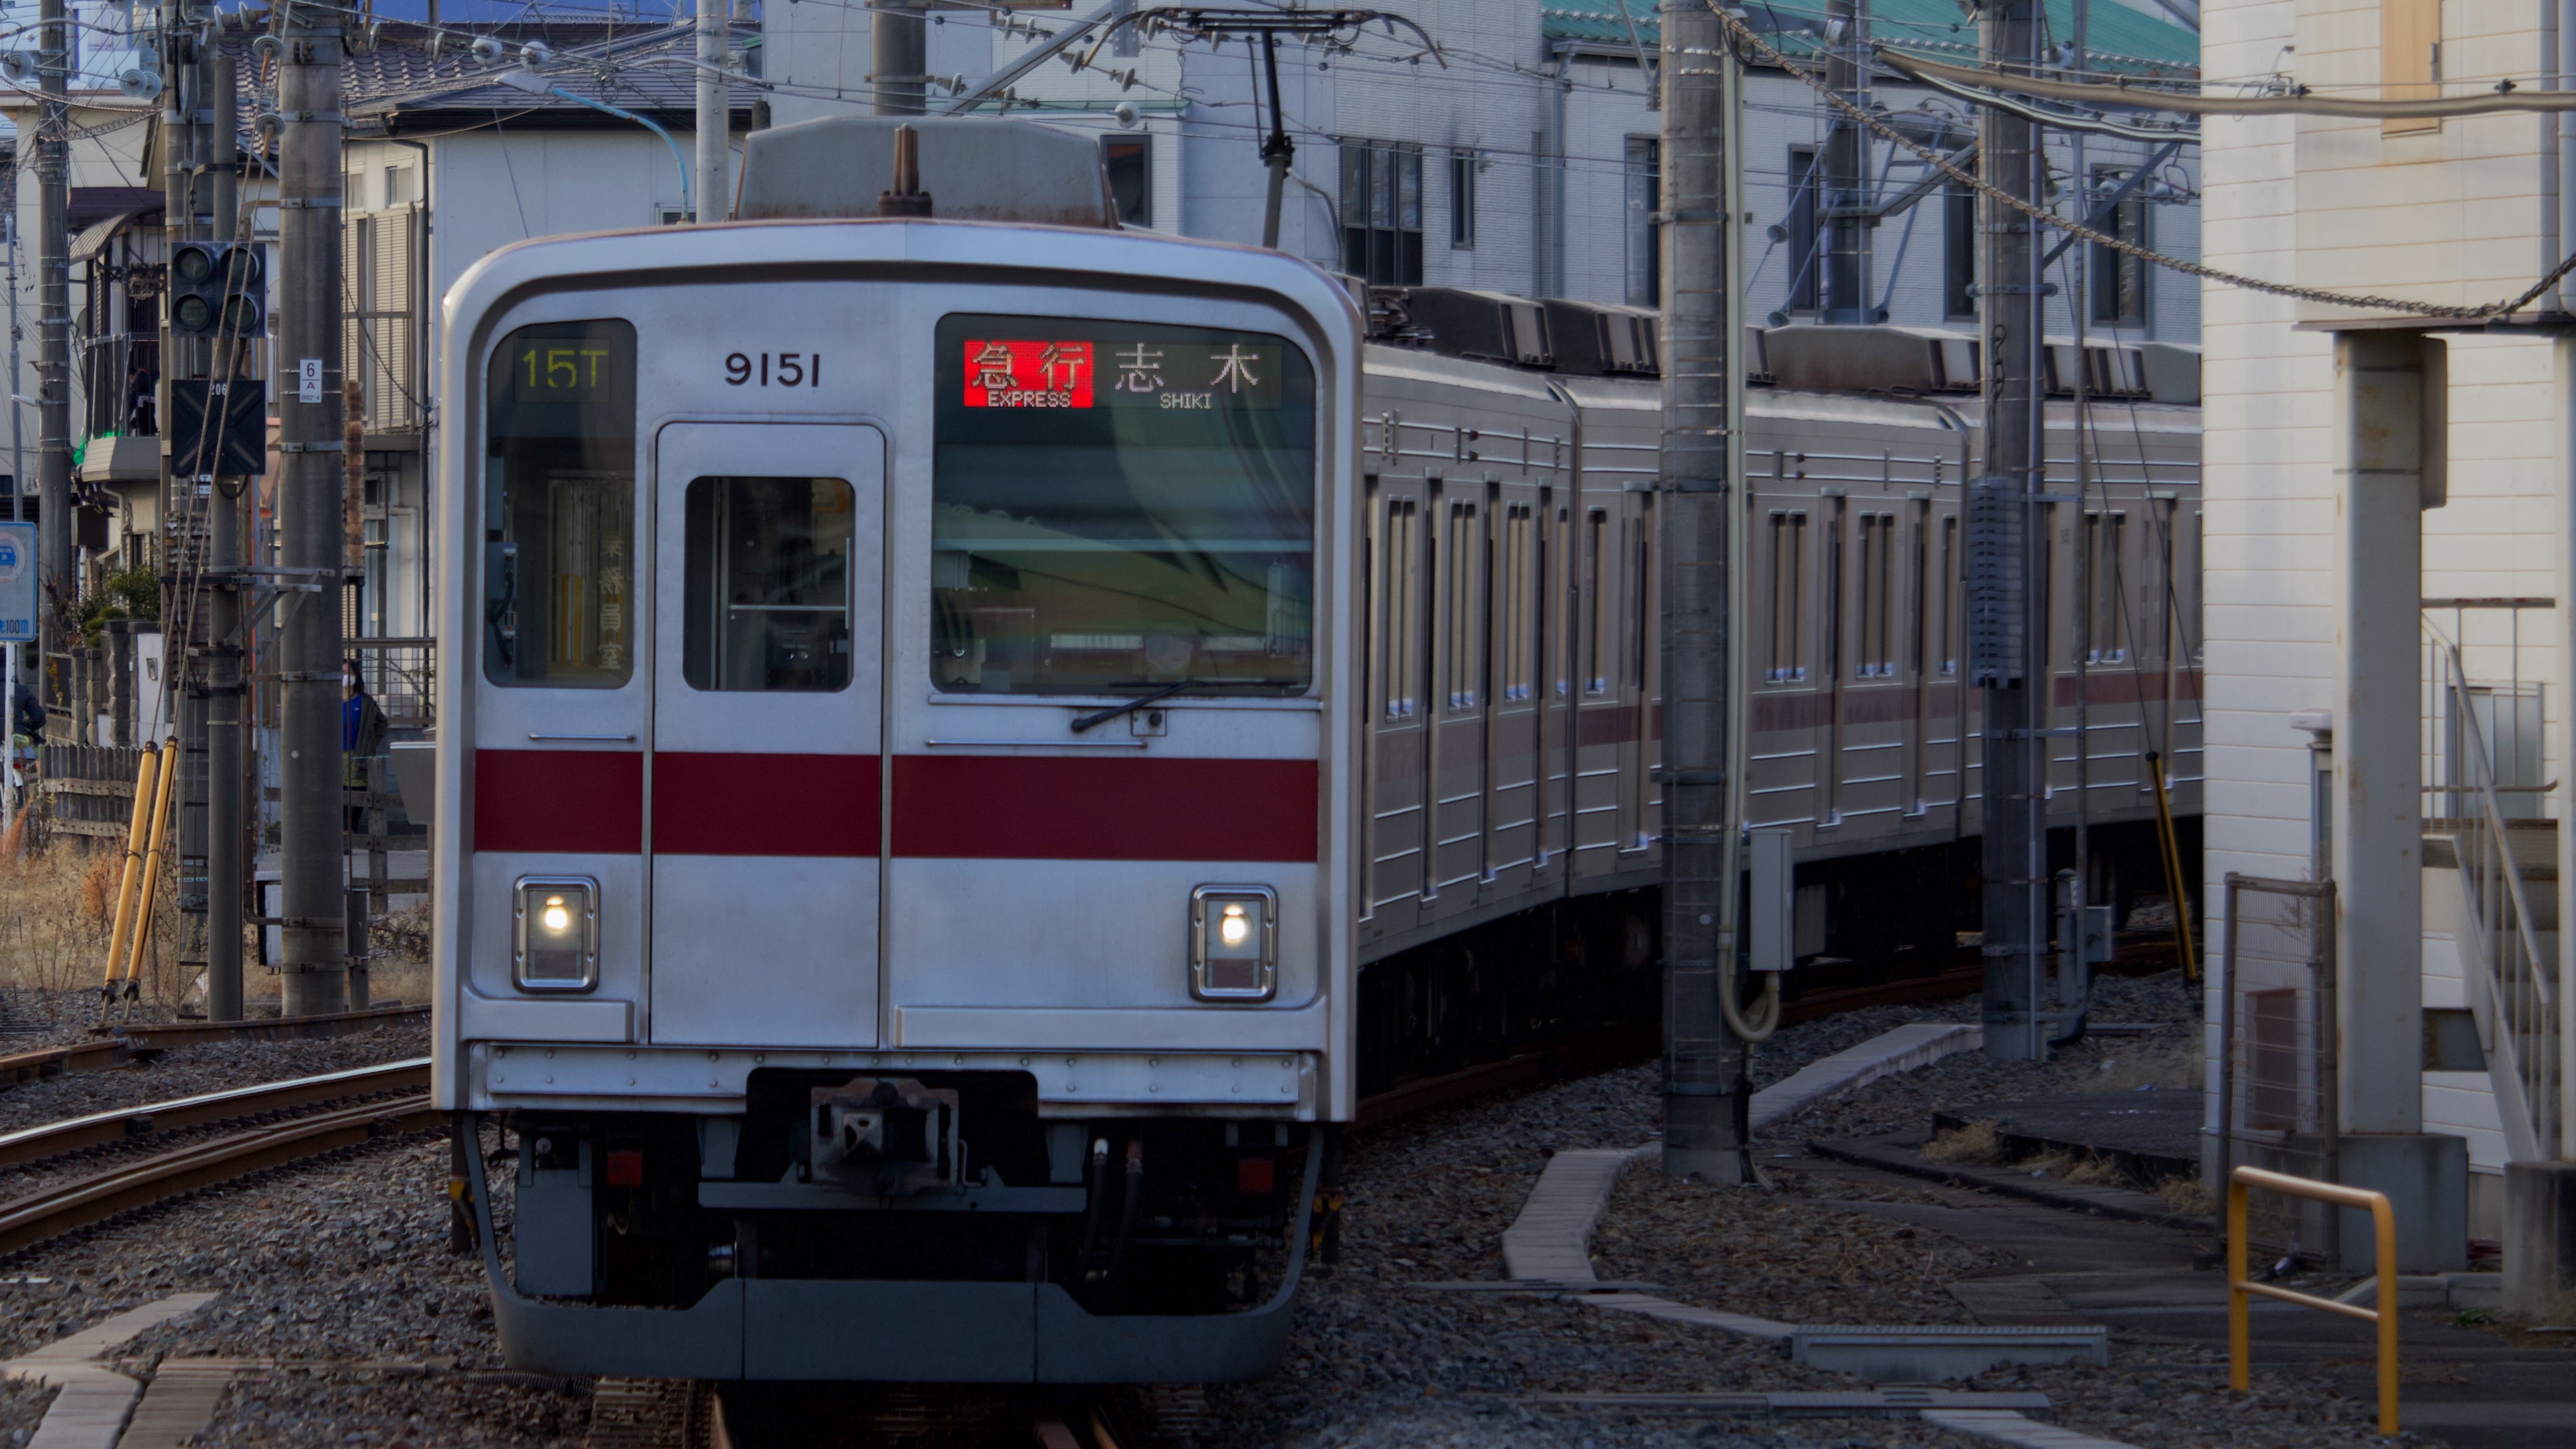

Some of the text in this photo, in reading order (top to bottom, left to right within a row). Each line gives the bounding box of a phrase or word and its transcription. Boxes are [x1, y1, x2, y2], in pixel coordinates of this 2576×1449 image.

[306, 362, 315, 378] 6
[522, 349, 609, 388] 15T
[725, 353, 819, 388] 9151
[972, 342, 1259, 393] 急行 志木
[306, 381, 315, 390] A
[988, 390, 1071, 408] EXPRESS
[1160, 392, 1211, 409] SHIKI
